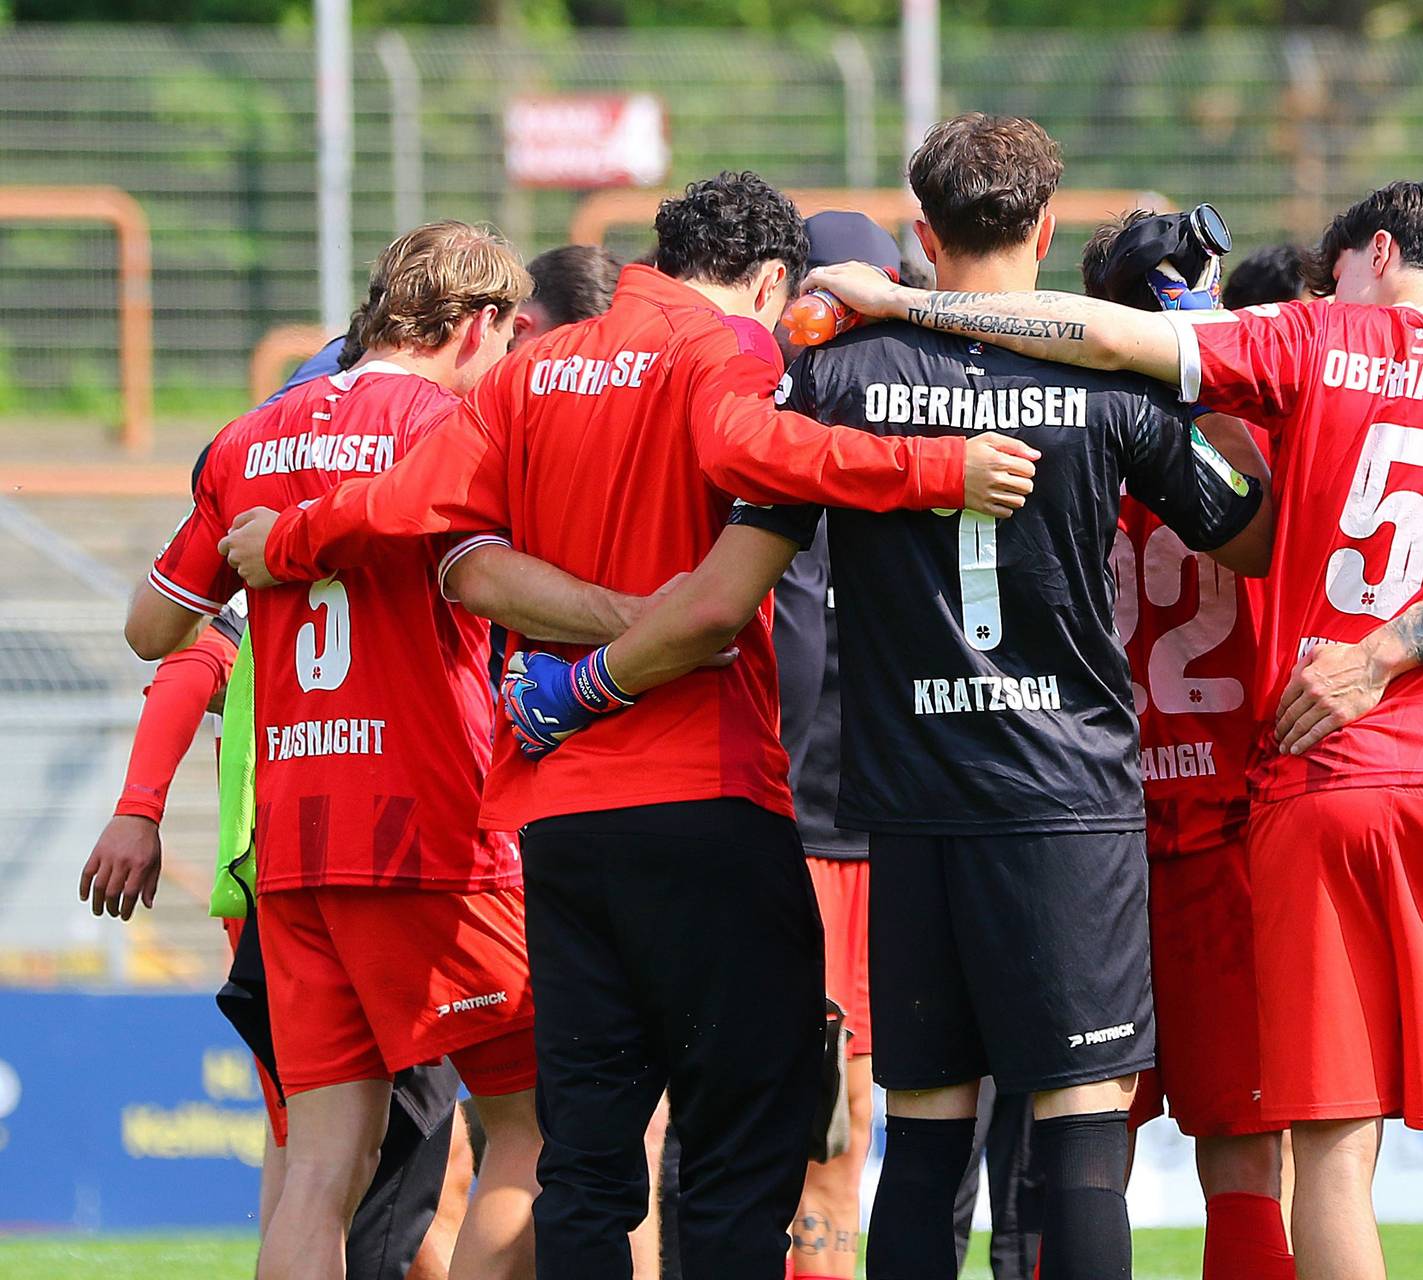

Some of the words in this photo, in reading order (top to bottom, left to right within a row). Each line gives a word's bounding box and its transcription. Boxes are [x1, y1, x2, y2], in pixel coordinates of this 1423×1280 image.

[865, 383, 1088, 430] OBERHAUSEN
[913, 675, 1061, 714] KRATZSCH
[452, 990, 508, 1012] PATRICK
[1084, 1022, 1135, 1045] PATRICK
